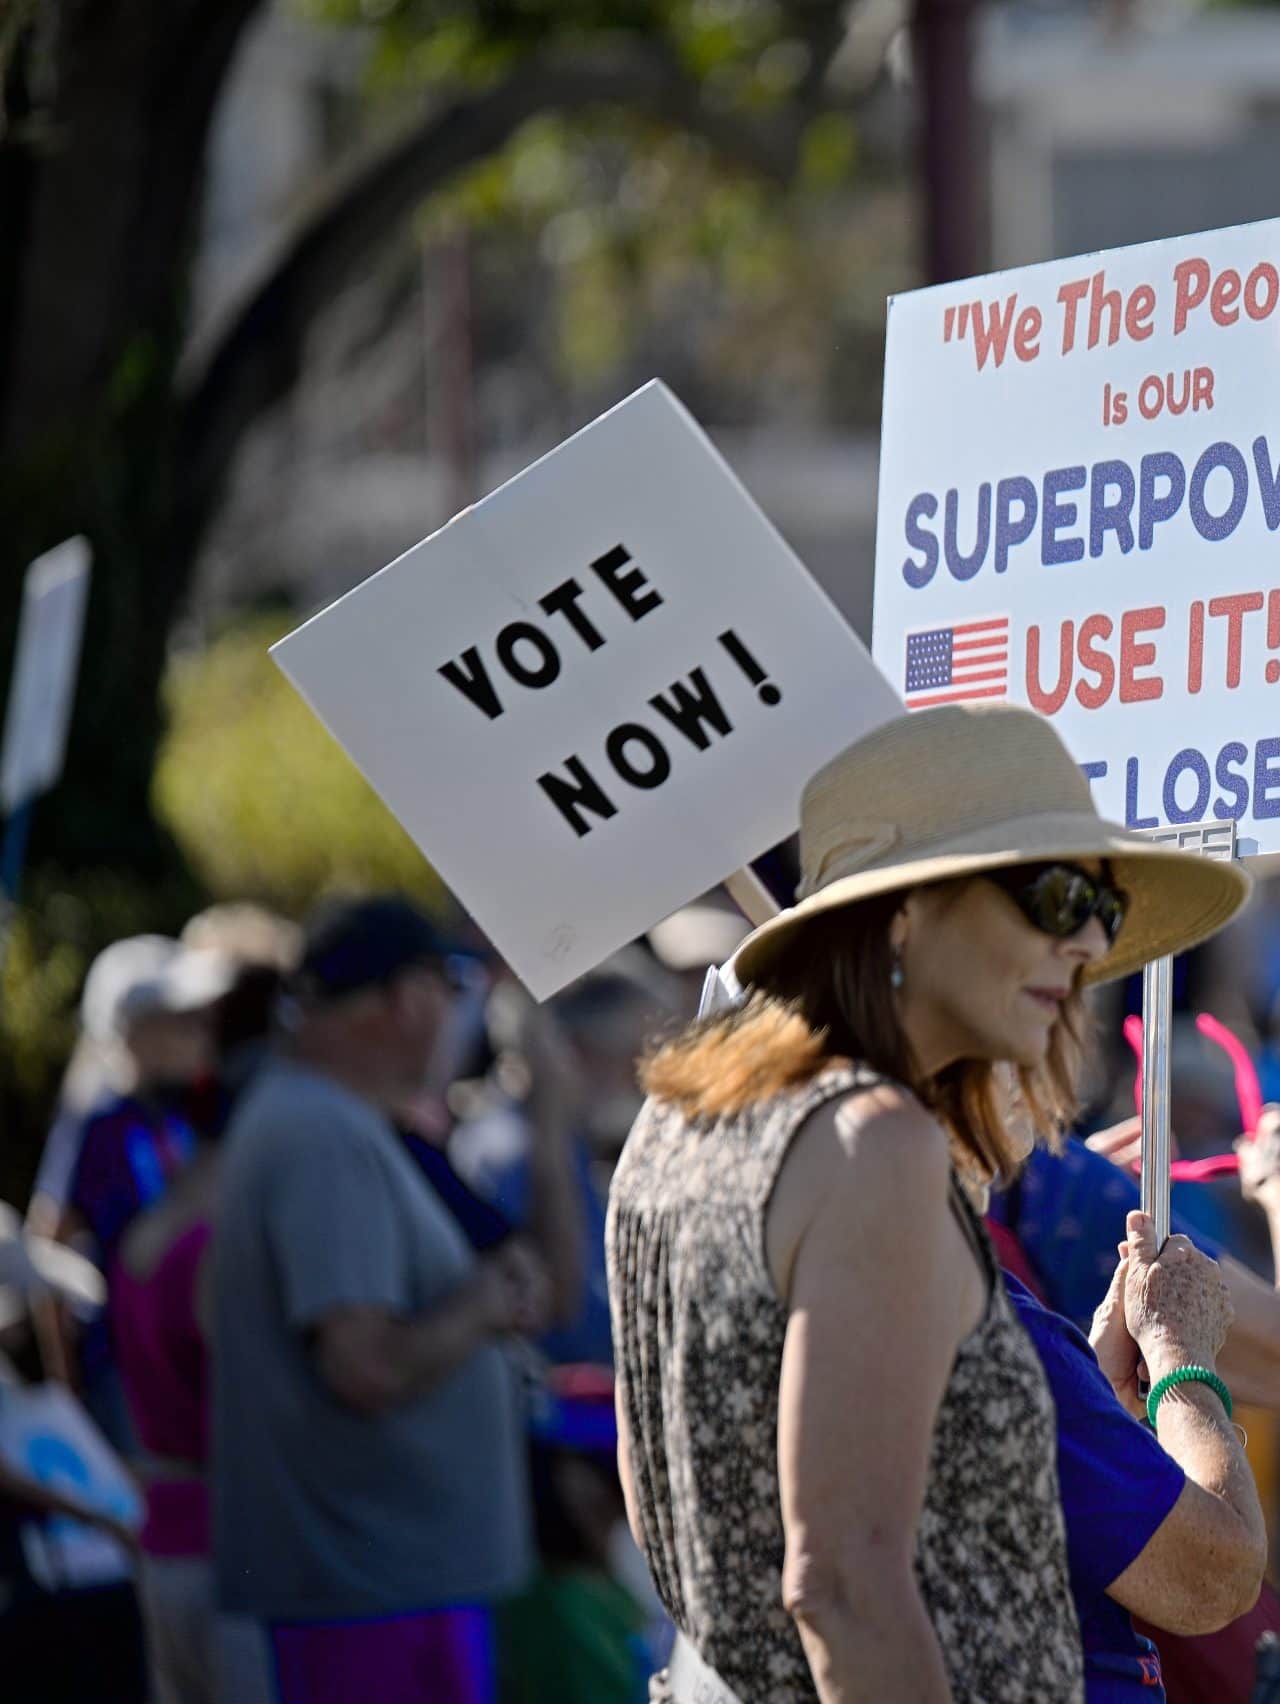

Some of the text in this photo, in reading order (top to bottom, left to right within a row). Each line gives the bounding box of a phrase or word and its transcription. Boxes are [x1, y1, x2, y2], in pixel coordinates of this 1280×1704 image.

[943, 293, 1043, 372] "We
[1056, 271, 1156, 357] The
[1102, 366, 1216, 427] Is OUR
[436, 543, 665, 722] VOTE
[1024, 605, 1167, 717] USE
[535, 628, 783, 839] NOW!
